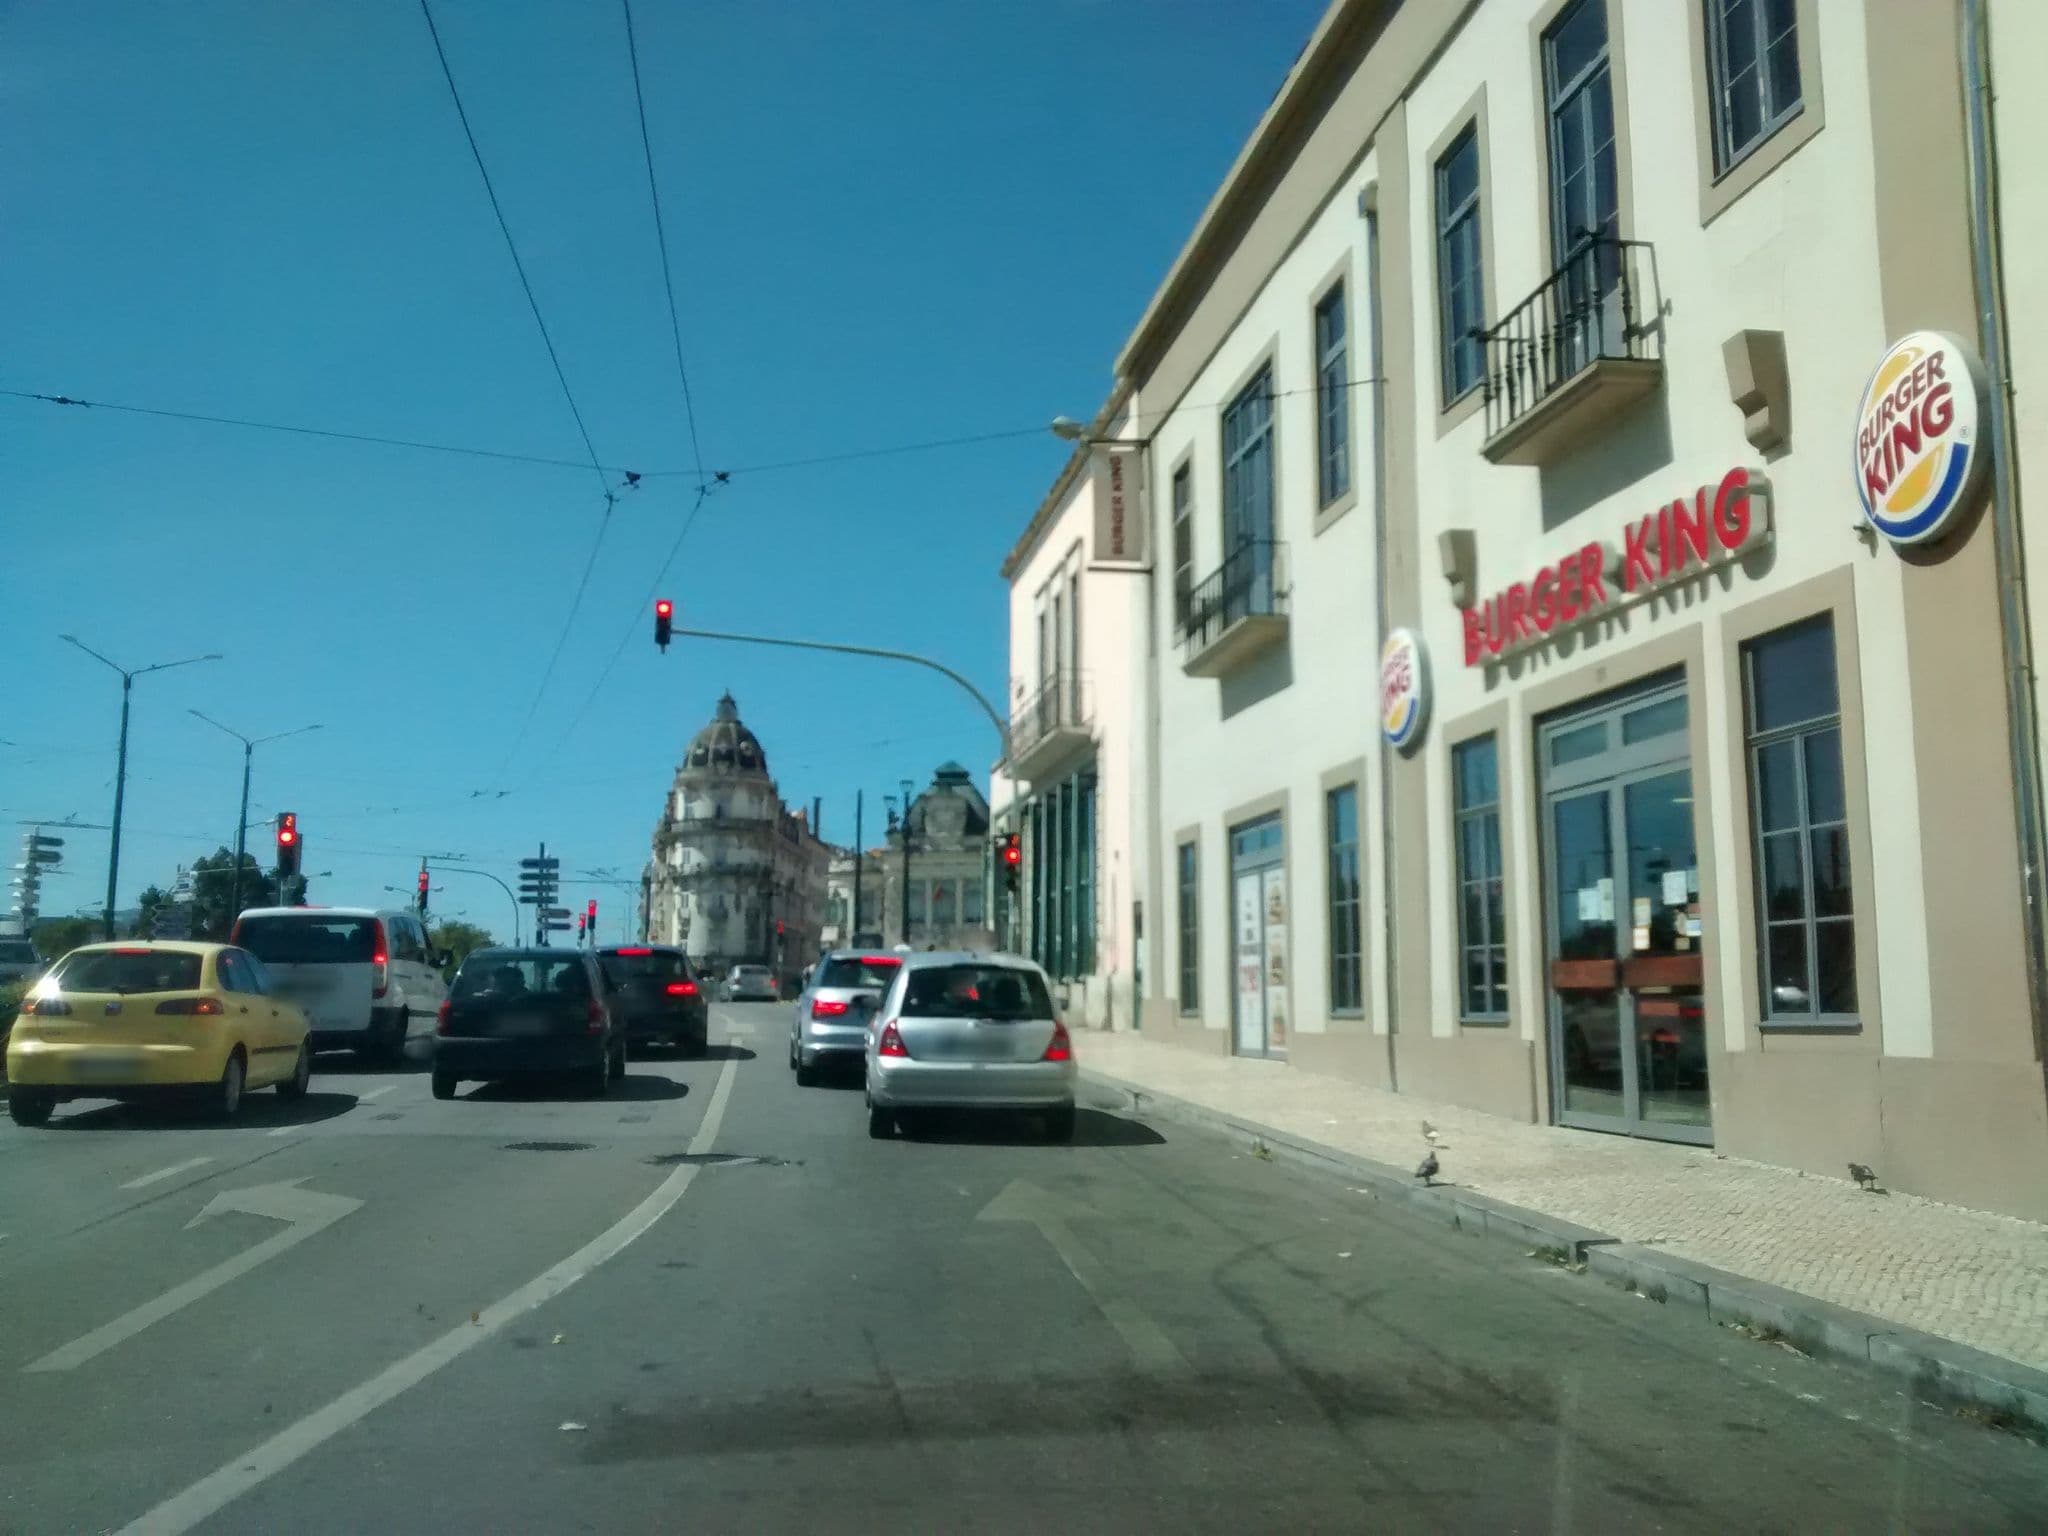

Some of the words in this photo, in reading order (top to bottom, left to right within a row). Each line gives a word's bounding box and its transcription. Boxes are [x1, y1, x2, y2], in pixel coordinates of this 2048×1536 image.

[1860, 350, 1944, 468] BURGER
[1864, 382, 1954, 515] KING
[1461, 541, 1606, 667] BURGER
[1625, 466, 1751, 592] KING
